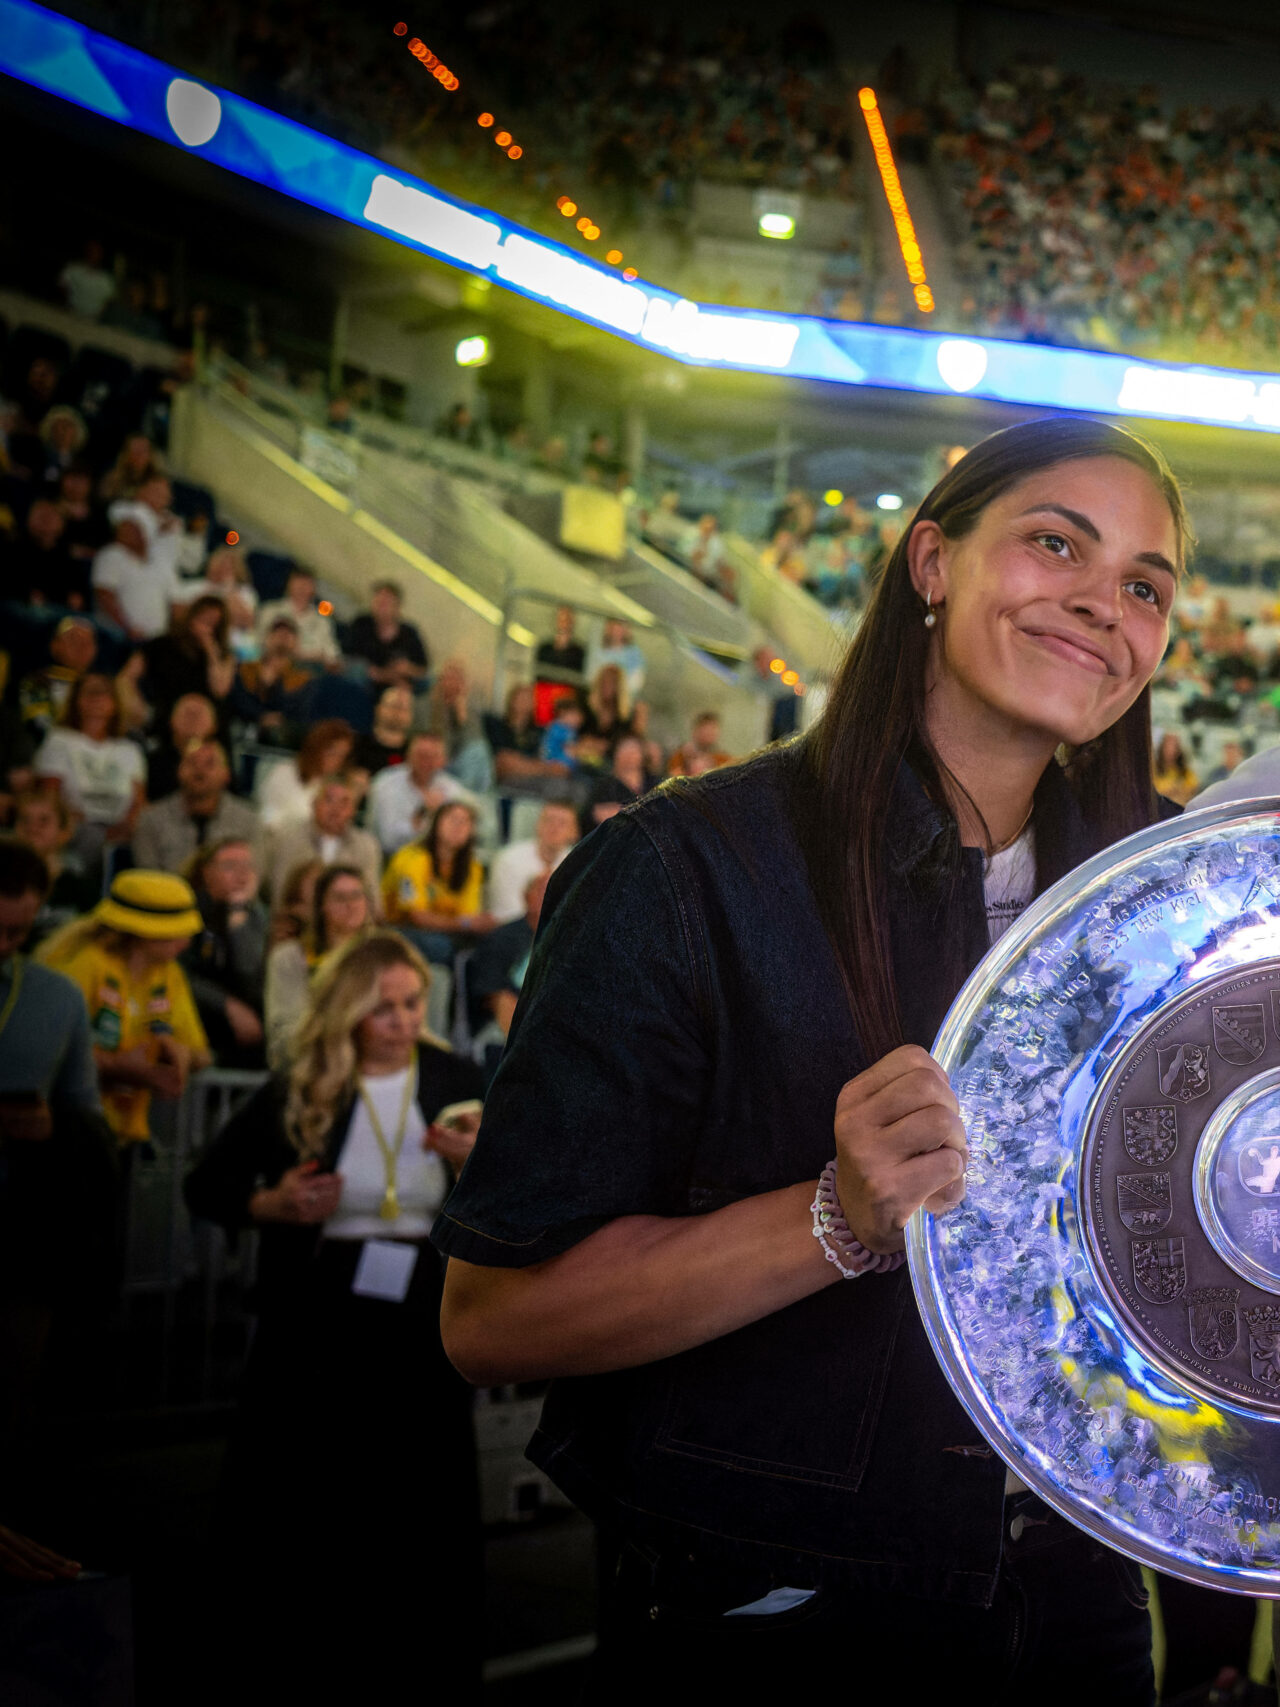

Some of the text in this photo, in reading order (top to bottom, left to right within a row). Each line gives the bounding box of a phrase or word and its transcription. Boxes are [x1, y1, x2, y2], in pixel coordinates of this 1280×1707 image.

[1130, 905, 1167, 935] THW
[1168, 889, 1202, 914] Kiel
[1215, 978, 1251, 998] SACHSEN
[1094, 1163, 1104, 1232] SACHSEN-ANHALT
[1115, 1272, 1141, 1312] SAARLAND
[1037, 1355, 1074, 1398] THW
[1231, 1380, 1260, 1395] BERLIN
